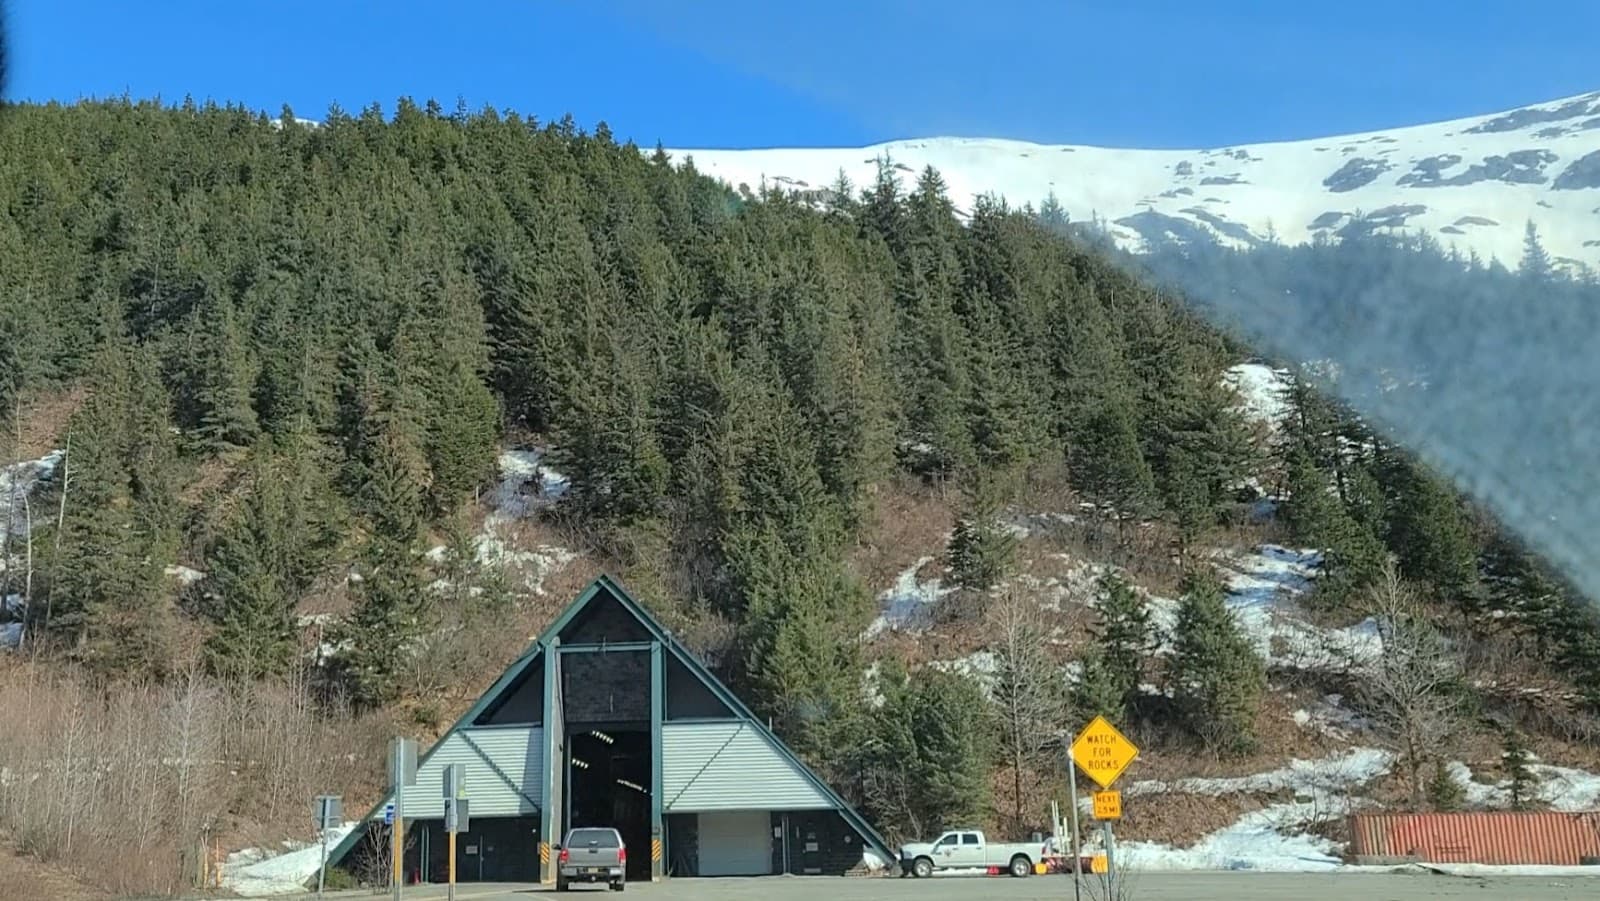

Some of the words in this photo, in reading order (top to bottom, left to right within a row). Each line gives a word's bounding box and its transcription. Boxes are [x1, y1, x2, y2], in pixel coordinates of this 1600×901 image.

[1086, 735, 1117, 745] WATCH
[1093, 747, 1112, 757] FOR
[1088, 760, 1119, 770] ROCKS
[1096, 794, 1116, 803] NEXT
